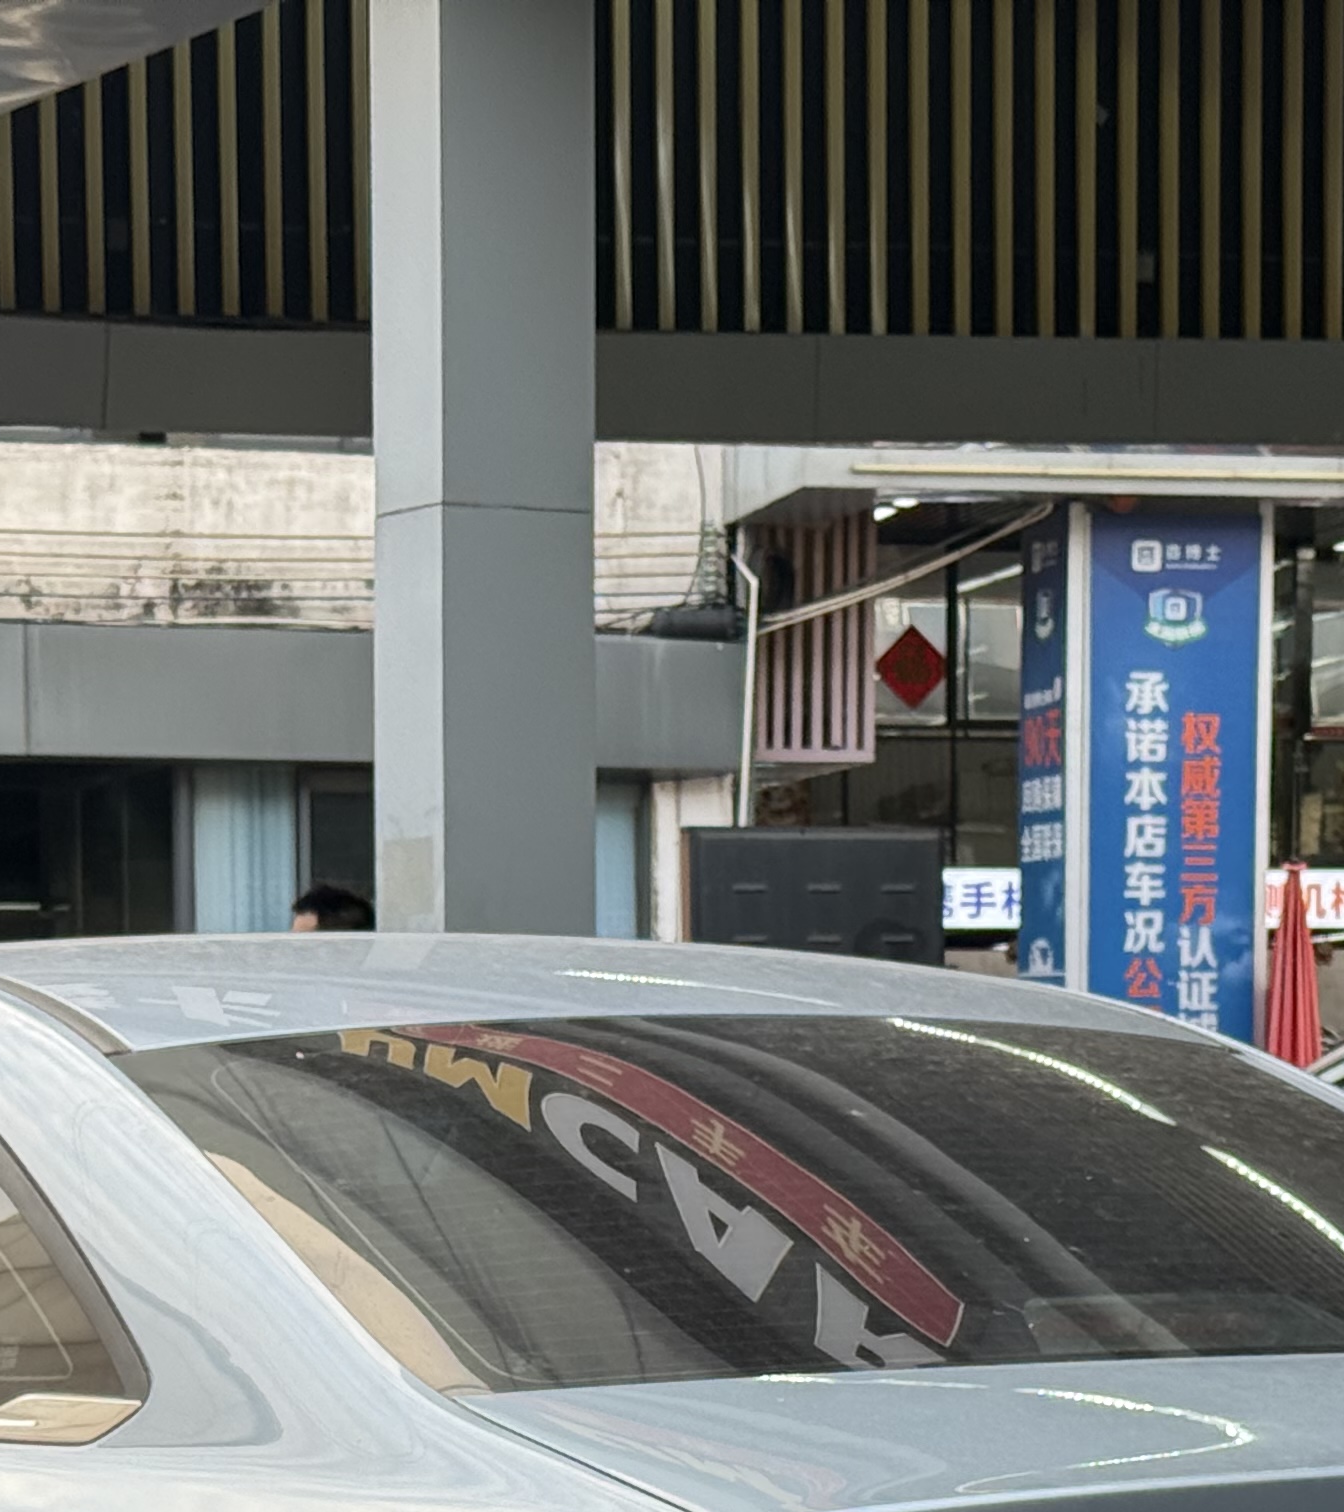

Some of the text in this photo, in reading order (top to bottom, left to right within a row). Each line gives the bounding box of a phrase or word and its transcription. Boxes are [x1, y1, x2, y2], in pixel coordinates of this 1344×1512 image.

[1123, 671, 1170, 1012] 承诺本店车况公
